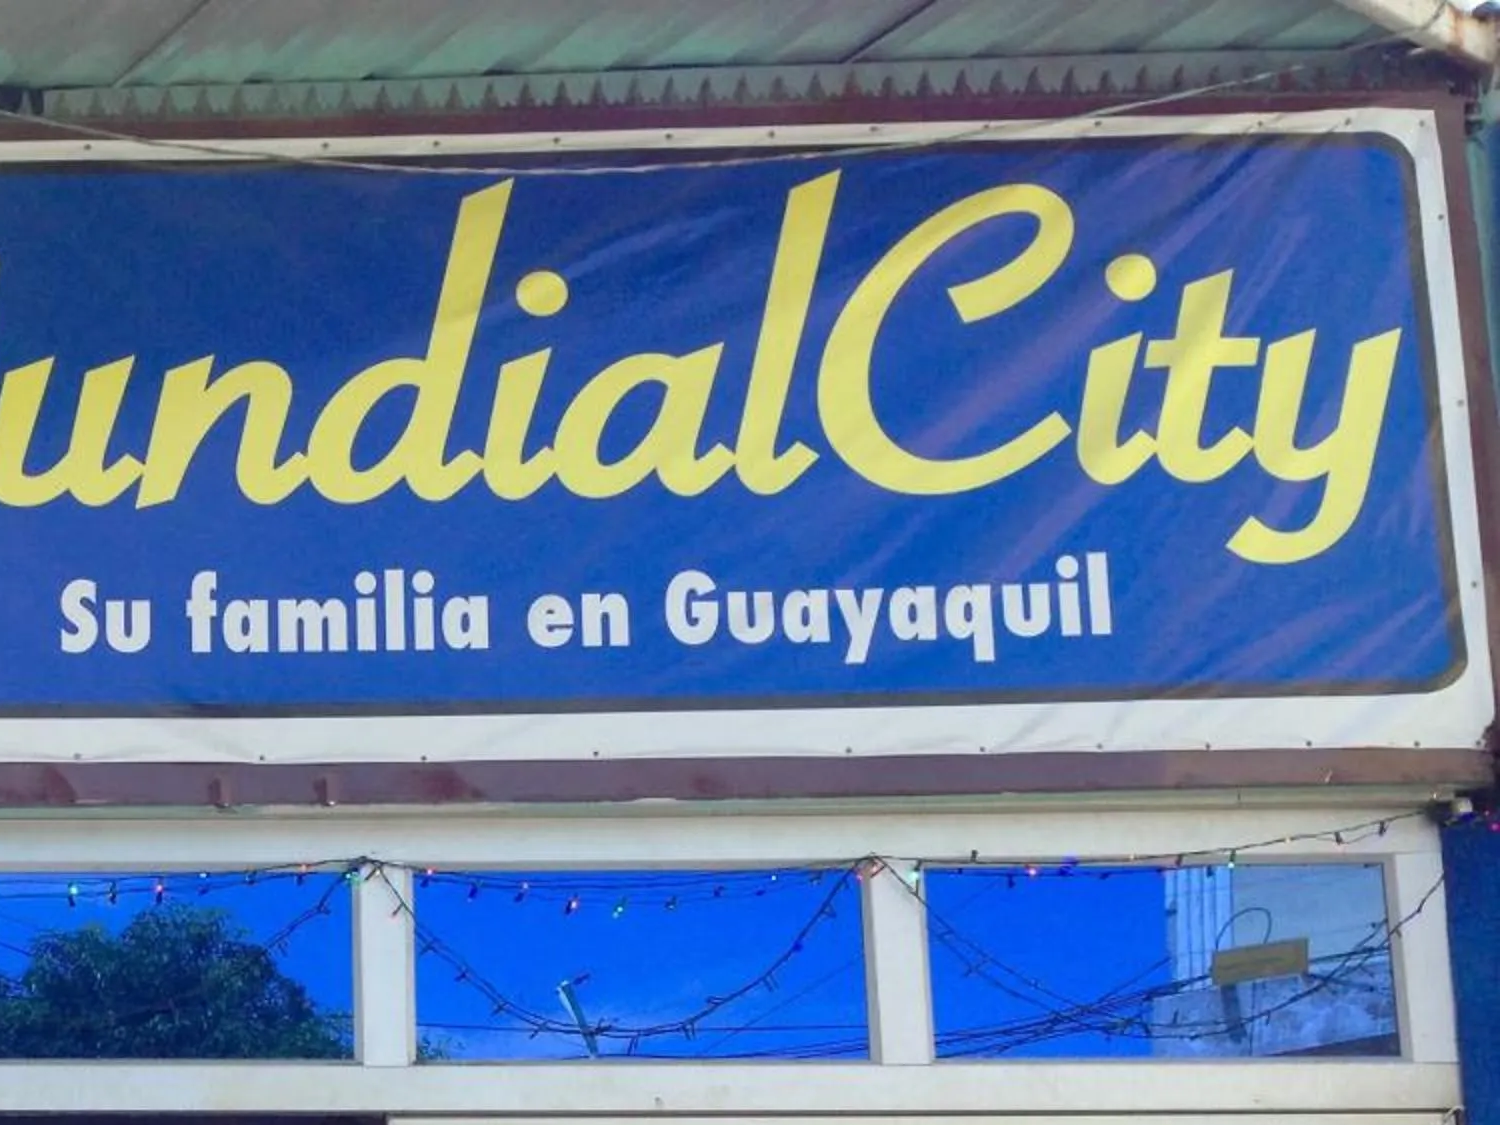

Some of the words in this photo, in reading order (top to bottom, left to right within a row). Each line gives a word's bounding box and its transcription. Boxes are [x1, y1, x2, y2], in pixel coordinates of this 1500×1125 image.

[60, 578, 151, 653] Su
[186, 568, 489, 653] familia
[527, 592, 630, 647] en
[665, 551, 1112, 663] Guayaquil
